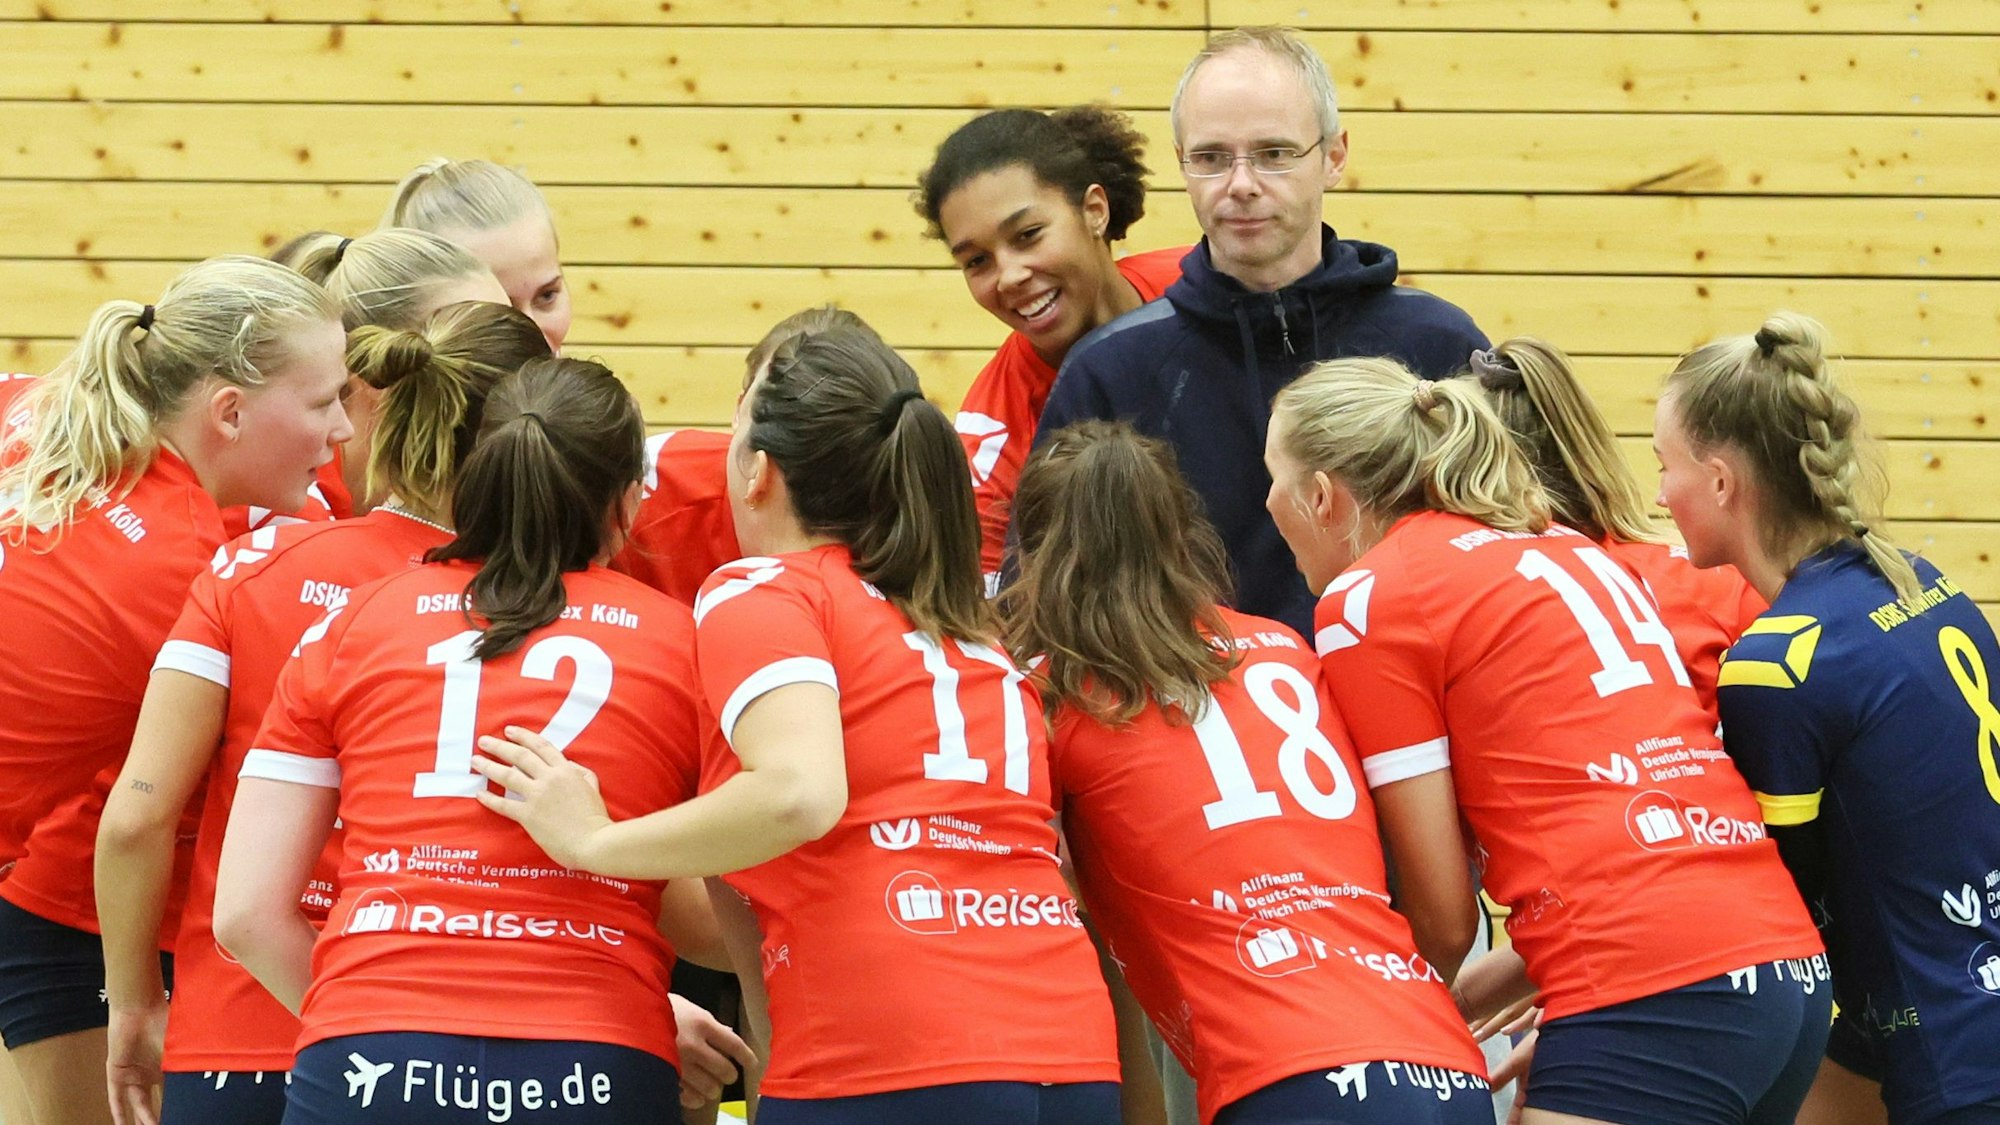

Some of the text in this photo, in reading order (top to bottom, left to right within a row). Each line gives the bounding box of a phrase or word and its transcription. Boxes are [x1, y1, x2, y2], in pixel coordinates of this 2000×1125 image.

[105, 503, 147, 544] Köln
[592, 603, 638, 629] Köln
[1515, 547, 1692, 698] 14
[1869, 602, 1908, 633] DSHS
[413, 629, 613, 799] 12
[902, 630, 1029, 796] 17
[1188, 661, 1356, 831] 18
[1635, 735, 1684, 756] Allfinanz
[1641, 748, 1690, 768] Deutsche
[1650, 765, 1681, 782] Ulrich
[131, 778, 154, 794] 2000
[929, 814, 982, 835] Allfinanz
[410, 845, 479, 860] Allfinanz
[406, 858, 476, 875] Deutsche
[1241, 871, 1305, 894] Allfinanz
[1244, 885, 1310, 909] Deutsche
[403, 1059, 611, 1123] Flüge.de
